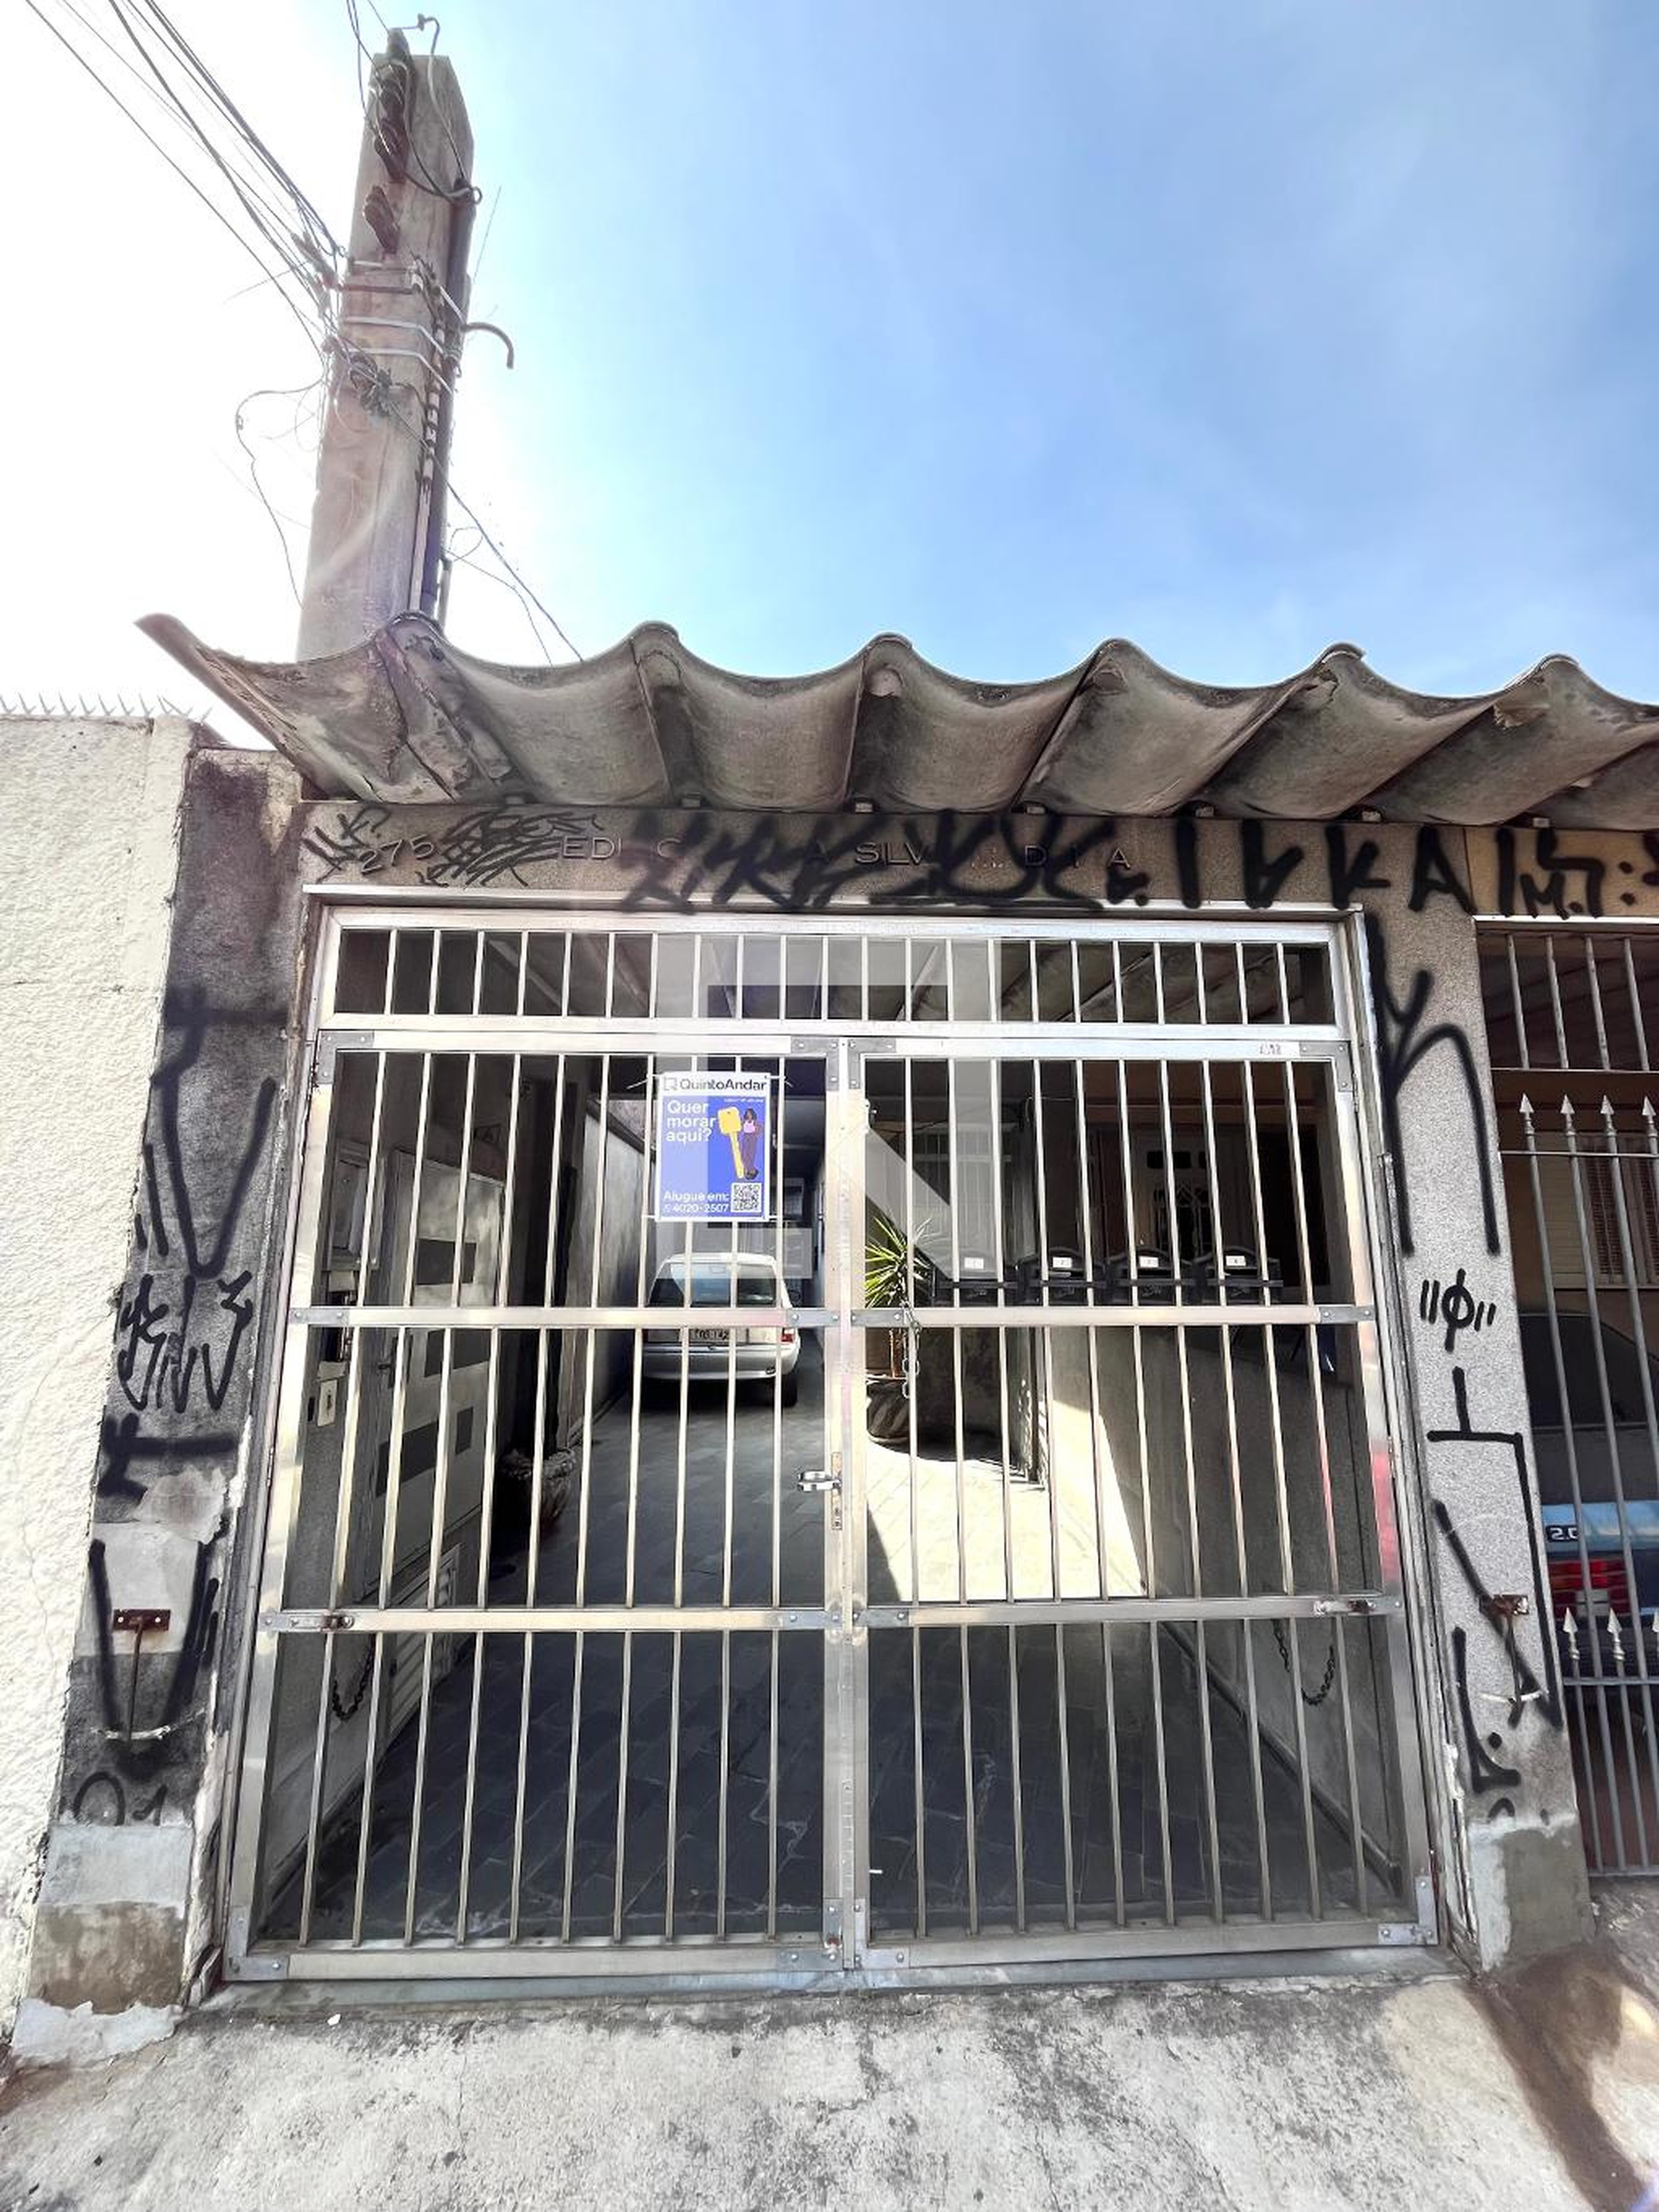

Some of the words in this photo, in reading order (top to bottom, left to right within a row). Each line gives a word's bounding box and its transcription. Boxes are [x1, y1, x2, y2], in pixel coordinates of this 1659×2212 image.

[359, 833, 434, 876] 275
[680, 1078, 767, 1091] QuintoAndar
[667, 1100, 709, 1115] Quer
[666, 1116, 717, 1128] morar
[666, 1127, 712, 1145] aqui?
[664, 1190, 706, 1203] Alugue
